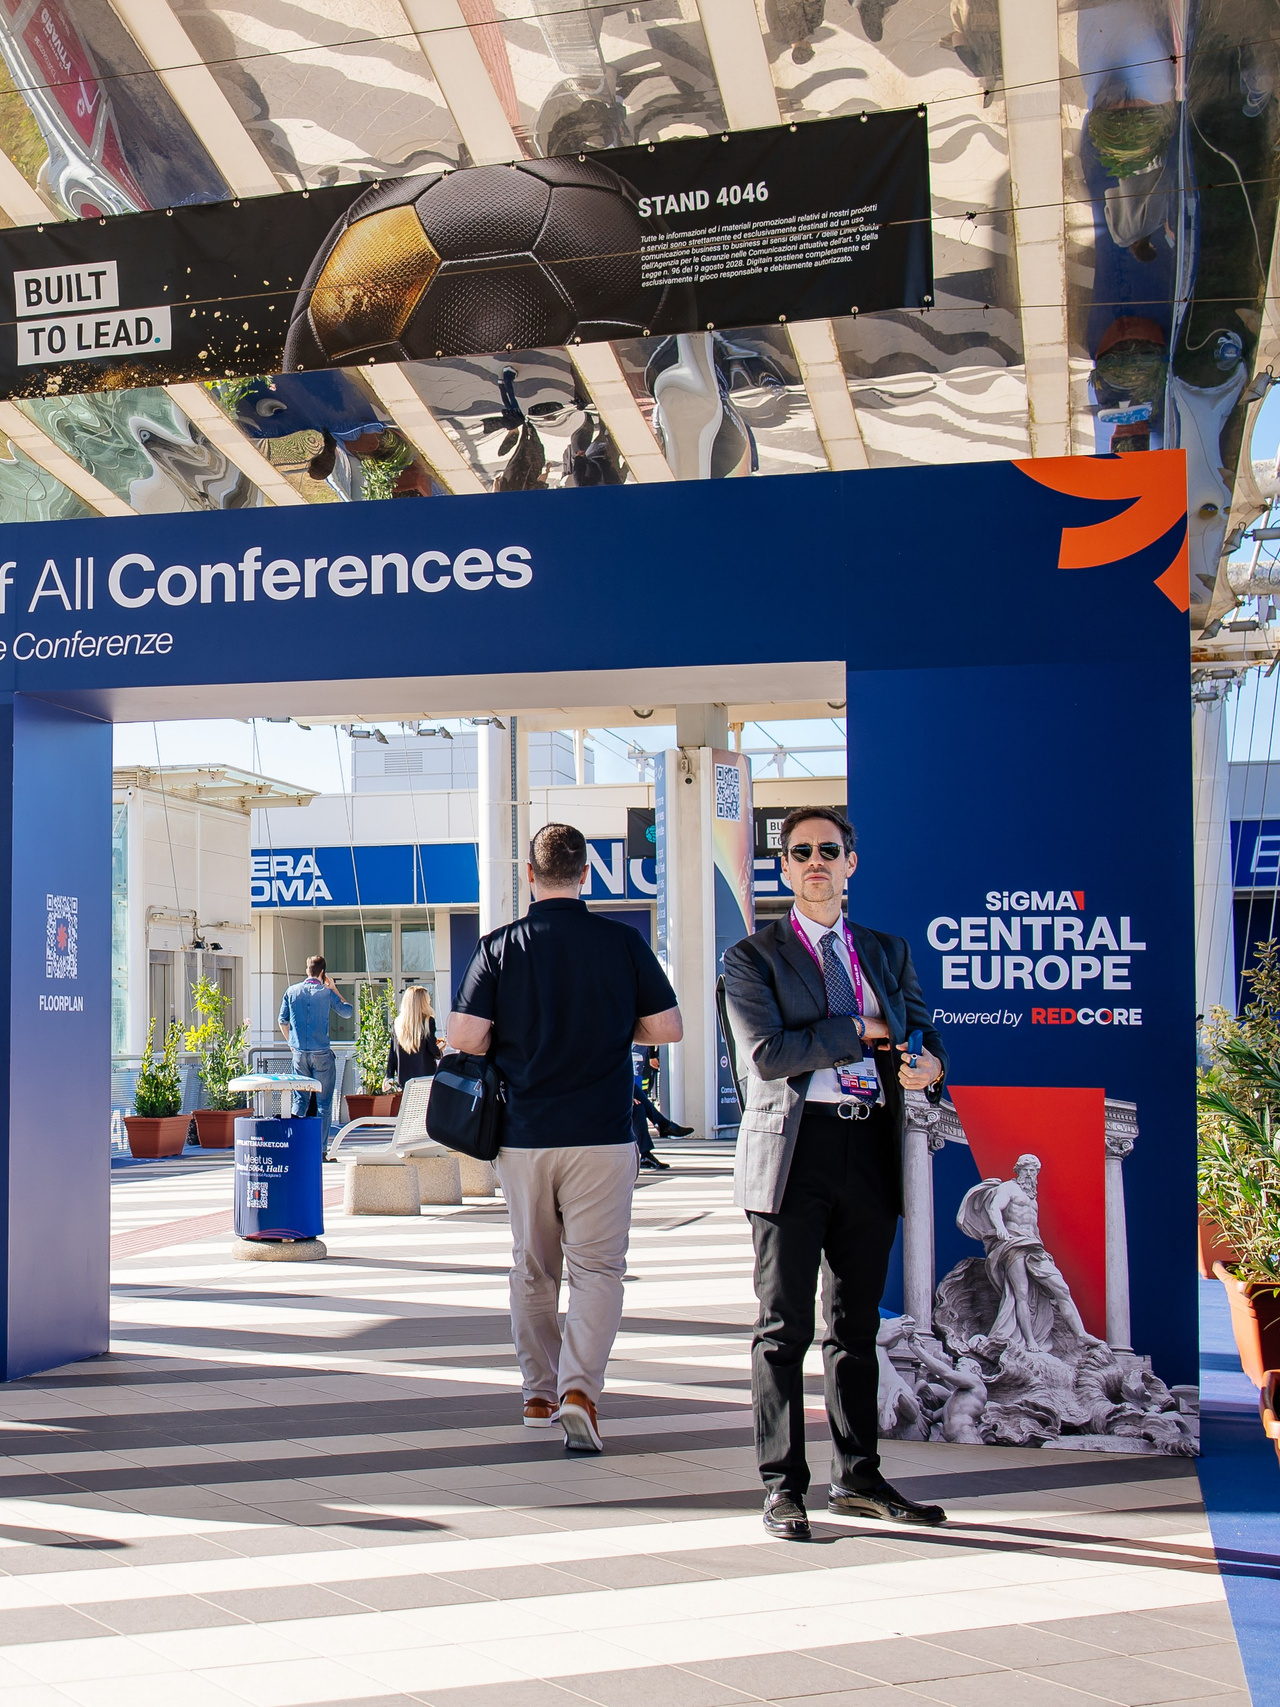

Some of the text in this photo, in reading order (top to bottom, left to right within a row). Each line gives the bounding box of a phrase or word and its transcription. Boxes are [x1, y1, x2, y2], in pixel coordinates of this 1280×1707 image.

[638, 181, 769, 218] STAND 4046
[640, 234, 656, 242] Tutte
[666, 227, 705, 239] informazioni
[721, 221, 750, 231] materiali
[752, 215, 796, 229] promozionali
[797, 212, 820, 221] relativi
[829, 208, 849, 217] nostri
[850, 204, 877, 216] prodotti
[646, 242, 668, 251] servizi
[688, 233, 730, 245] strettamente
[743, 224, 796, 238] esclusivamente
[798, 220, 827, 231] destinati
[641, 258, 678, 271] dell'Agenzia
[680, 258, 691, 266] per
[700, 252, 729, 262] Garanzie
[730, 249, 746, 258] nelle
[748, 243, 797, 256] Comunicazioni
[798, 239, 828, 249] attuative
[830, 236, 853, 245] dell'art.
[861, 232, 878, 241] della
[641, 269, 661, 280] Legge
[700, 261, 724, 273] agosto
[746, 255, 772, 267] Digitain
[774, 251, 803, 262] sostiene
[805, 244, 859, 259] completamente
[641, 274, 692, 287] esclusivamente
[699, 271, 717, 281] gioco
[719, 265, 762, 279] responsabile
[770, 259, 812, 271] debitamente
[814, 254, 852, 266] autorizzato.
[24, 270, 107, 308] BUILT
[28, 315, 162, 356] TO LEAD.
[28, 556, 94, 613] All
[108, 545, 533, 609] Conferences
[13, 628, 174, 660] Conferenze
[985, 890, 1080, 912] SiGMA
[926, 915, 1147, 952] CENTRAL
[942, 955, 1132, 991] EUROPE
[39, 995, 84, 1013] FLOORPLAN
[932, 1008, 1143, 1028] Powered by REDCORE
[262, 1157, 273, 1165] us
[266, 1165, 283, 1173] Hall
[284, 1165, 289, 1173] 5
